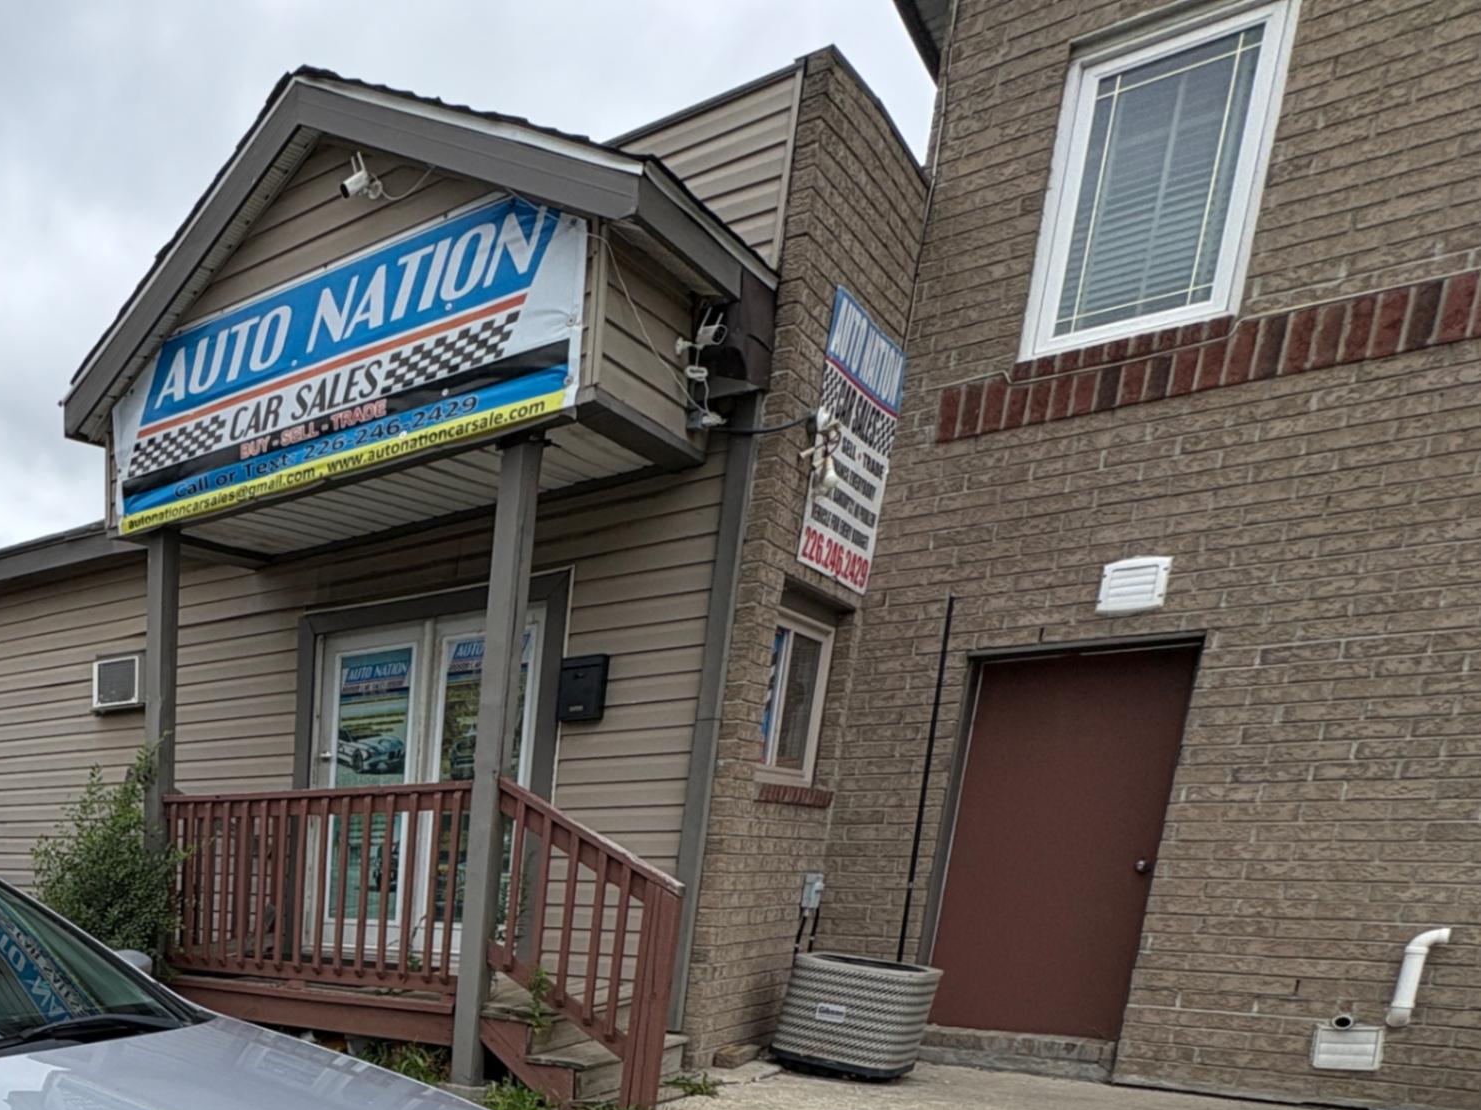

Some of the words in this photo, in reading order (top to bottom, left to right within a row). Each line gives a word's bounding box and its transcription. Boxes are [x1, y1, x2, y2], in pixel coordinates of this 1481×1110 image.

[155, 305, 292, 408] AUTO
[306, 206, 547, 354] NATION
[830, 298, 868, 374] AUTO
[230, 396, 283, 441] CAR
[291, 360, 383, 421] SALES
[240, 435, 271, 459] BUY
[280, 421, 319, 446] SELL
[330, 399, 387, 430] TRADE
[326, 400, 546, 474] www.autonationcarsale.com
[175, 473, 209, 498] Call
[216, 470, 236, 486] or
[303, 396, 479, 460] 226-246-2429
